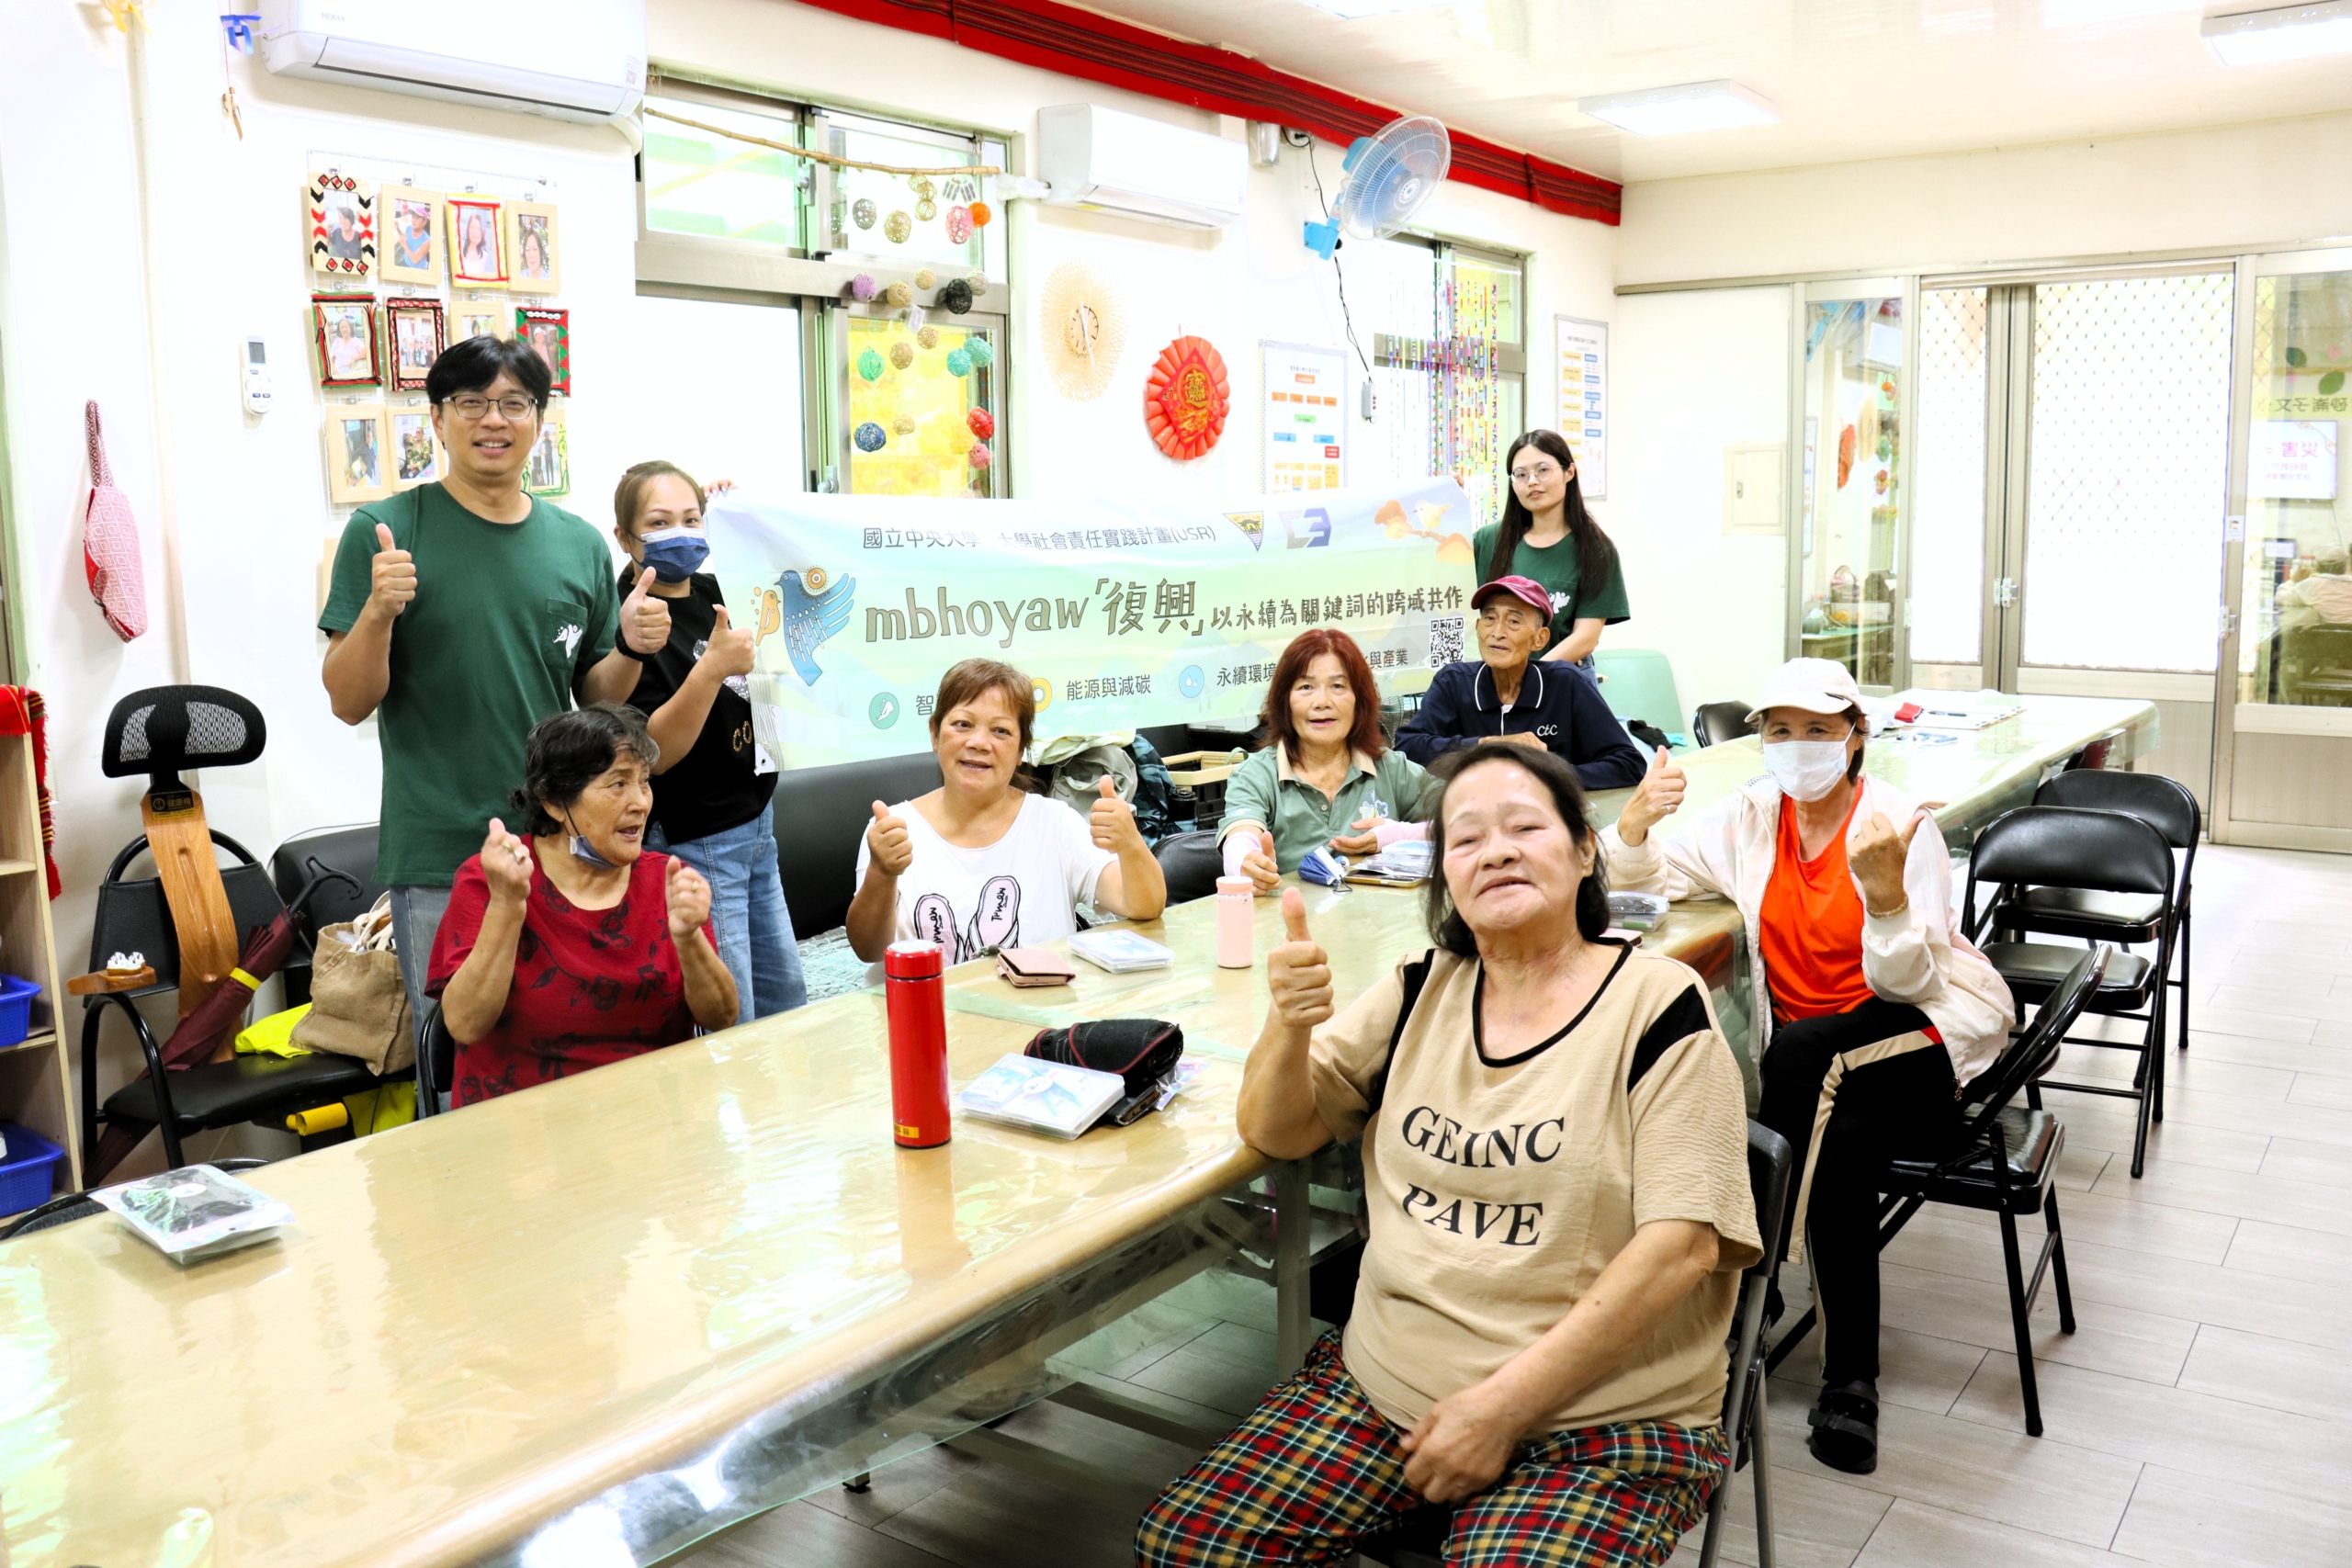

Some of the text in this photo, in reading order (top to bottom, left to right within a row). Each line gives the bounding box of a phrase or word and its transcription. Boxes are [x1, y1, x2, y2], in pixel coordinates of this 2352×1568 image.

[321, 11, 346, 22] HERAN
[863, 524, 1217, 551] 國立中央大學 大學社會責任實踐計畫(USR)
[865, 585, 1090, 649] mbhoyaw
[1210, 585, 1464, 631] 以永續為關鍵詞的跨域共作
[1364, 647, 1408, 670] 與產業
[1216, 661, 1277, 687] 永續環境
[1066, 674, 1152, 702] 能源與減碳
[1401, 1105, 1565, 1168] GEINC
[1402, 1182, 1544, 1247] PAVE
